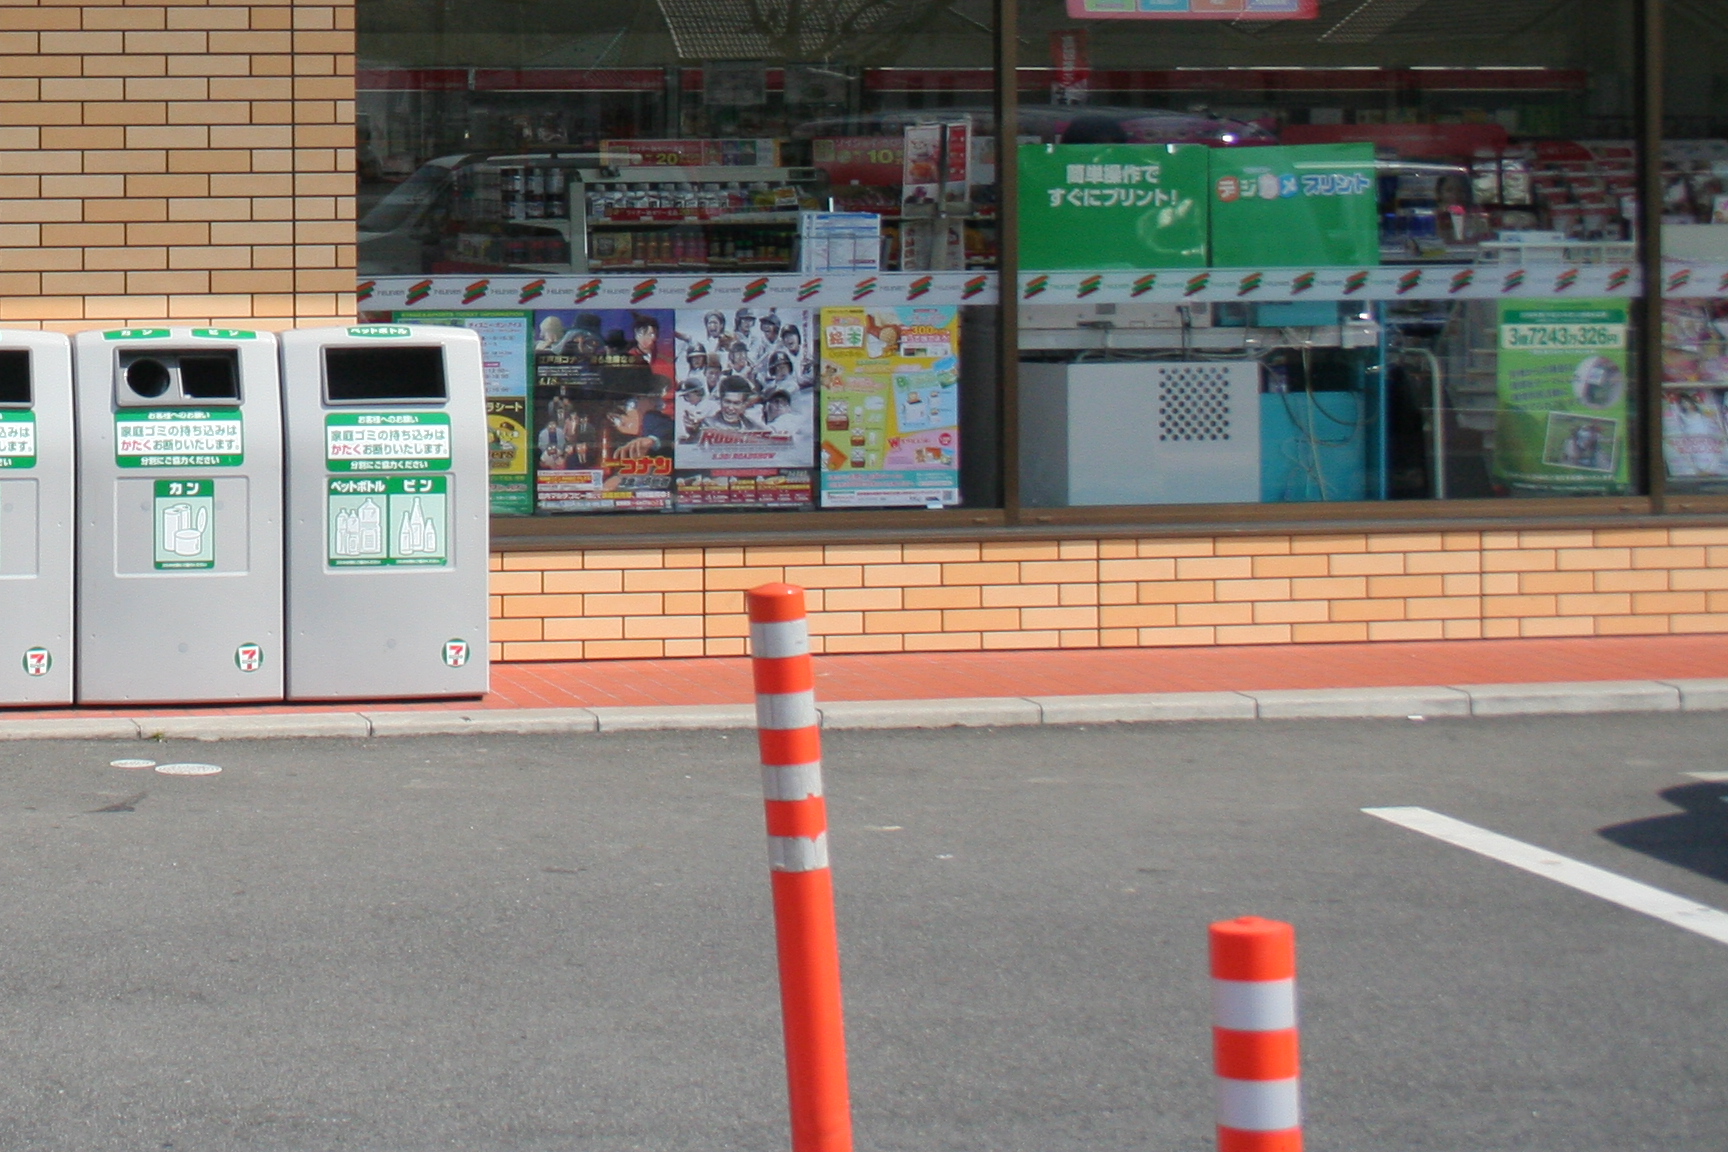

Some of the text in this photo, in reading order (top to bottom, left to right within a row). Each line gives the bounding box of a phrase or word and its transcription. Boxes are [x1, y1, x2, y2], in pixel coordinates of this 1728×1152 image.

[1066, 163, 1161, 184] 簡単操作で
[1217, 175, 1299, 202] デジメ
[1047, 187, 1178, 208] すぐにプリント!
[350, 327, 408, 335] ペットボトル
[120, 425, 238, 437] 家庭ゴミの持ち込みは
[330, 430, 446, 442] 家庭ゴミの持ち込みは
[121, 440, 240, 452] かたくお断りいたします。
[331, 443, 448, 455] かたくお断りいたします。
[169, 482, 200, 495] カン
[330, 480, 386, 492] ペットボトル
[403, 479, 433, 492] ビン
